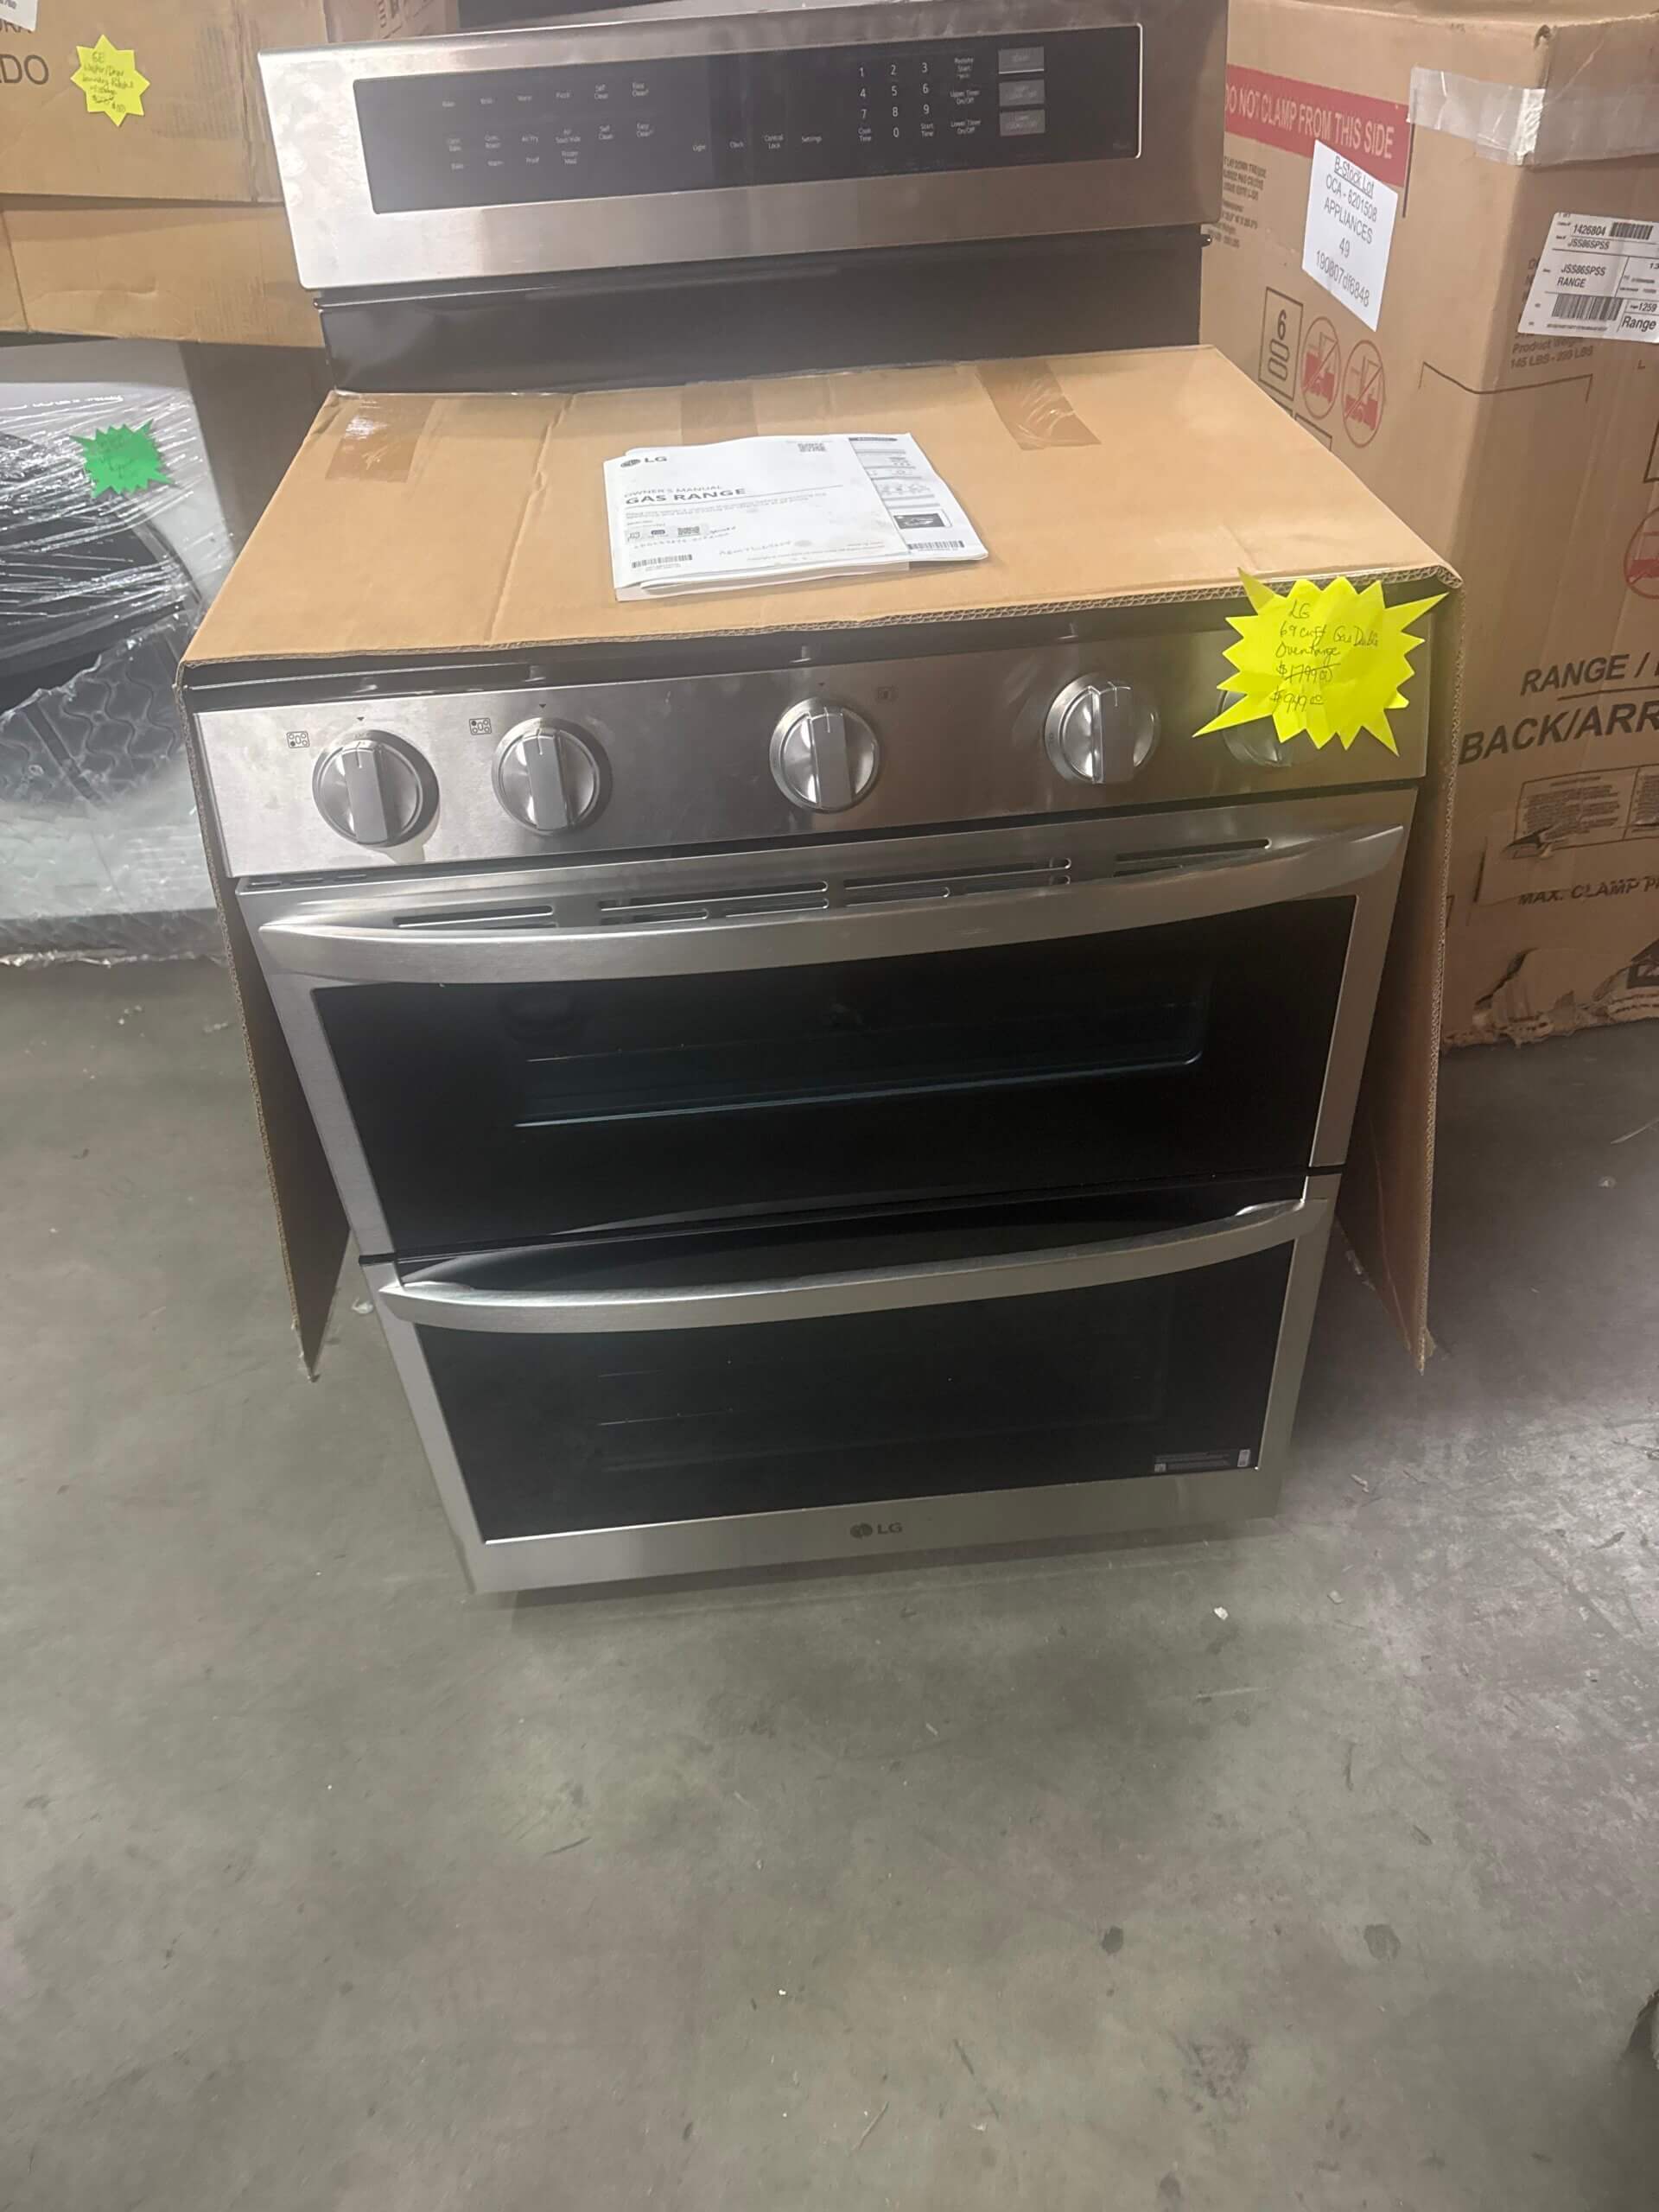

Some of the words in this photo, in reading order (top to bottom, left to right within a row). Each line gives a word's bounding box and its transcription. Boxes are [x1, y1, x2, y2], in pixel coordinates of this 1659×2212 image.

[0, 54, 49, 85] DO
[858, 67, 864, 77] 1
[891, 64, 897, 76] 2
[921, 62, 928, 73] 3
[860, 87, 866, 98] 4
[891, 85, 898, 96] 5
[922, 83, 929, 94] 6
[861, 109, 867, 118] 7
[892, 106, 899, 118] 8
[923, 104, 930, 115] 9
[1239, 85, 1261, 119] NOT
[1261, 94, 1297, 131] CLAMP
[1298, 103, 1332, 142] FROM
[1334, 112, 1363, 151] THIS
[1363, 120, 1395, 160] SIDE
[893, 127, 899, 137] 0
[1334, 156, 1361, 189] B-Stock
[1362, 176, 1375, 197] Lot
[1325, 174, 1342, 197] OCA
[1347, 188, 1377, 223] 6201508
[1324, 197, 1373, 245] APPLIANCES
[1573, 223, 1606, 237] 1426804
[1338, 238, 1351, 258] 49
[1316, 251, 1370, 308] 190807df6848
[1556, 276, 1586, 289] RANGE
[1277, 309, 1287, 340] 6
[1622, 315, 1656, 333] Range
[1529, 353, 1550, 366] LBS
[1574, 346, 1593, 359] LBS
[625, 494, 667, 505] GAS
[673, 488, 747, 502] RANGE
[1288, 598, 1310, 620] LG
[1520, 654, 1630, 696] RANGE
[1518, 889, 1563, 906] MAX.
[1570, 877, 1641, 899] CLAMP
[877, 1522, 903, 1535] LG
